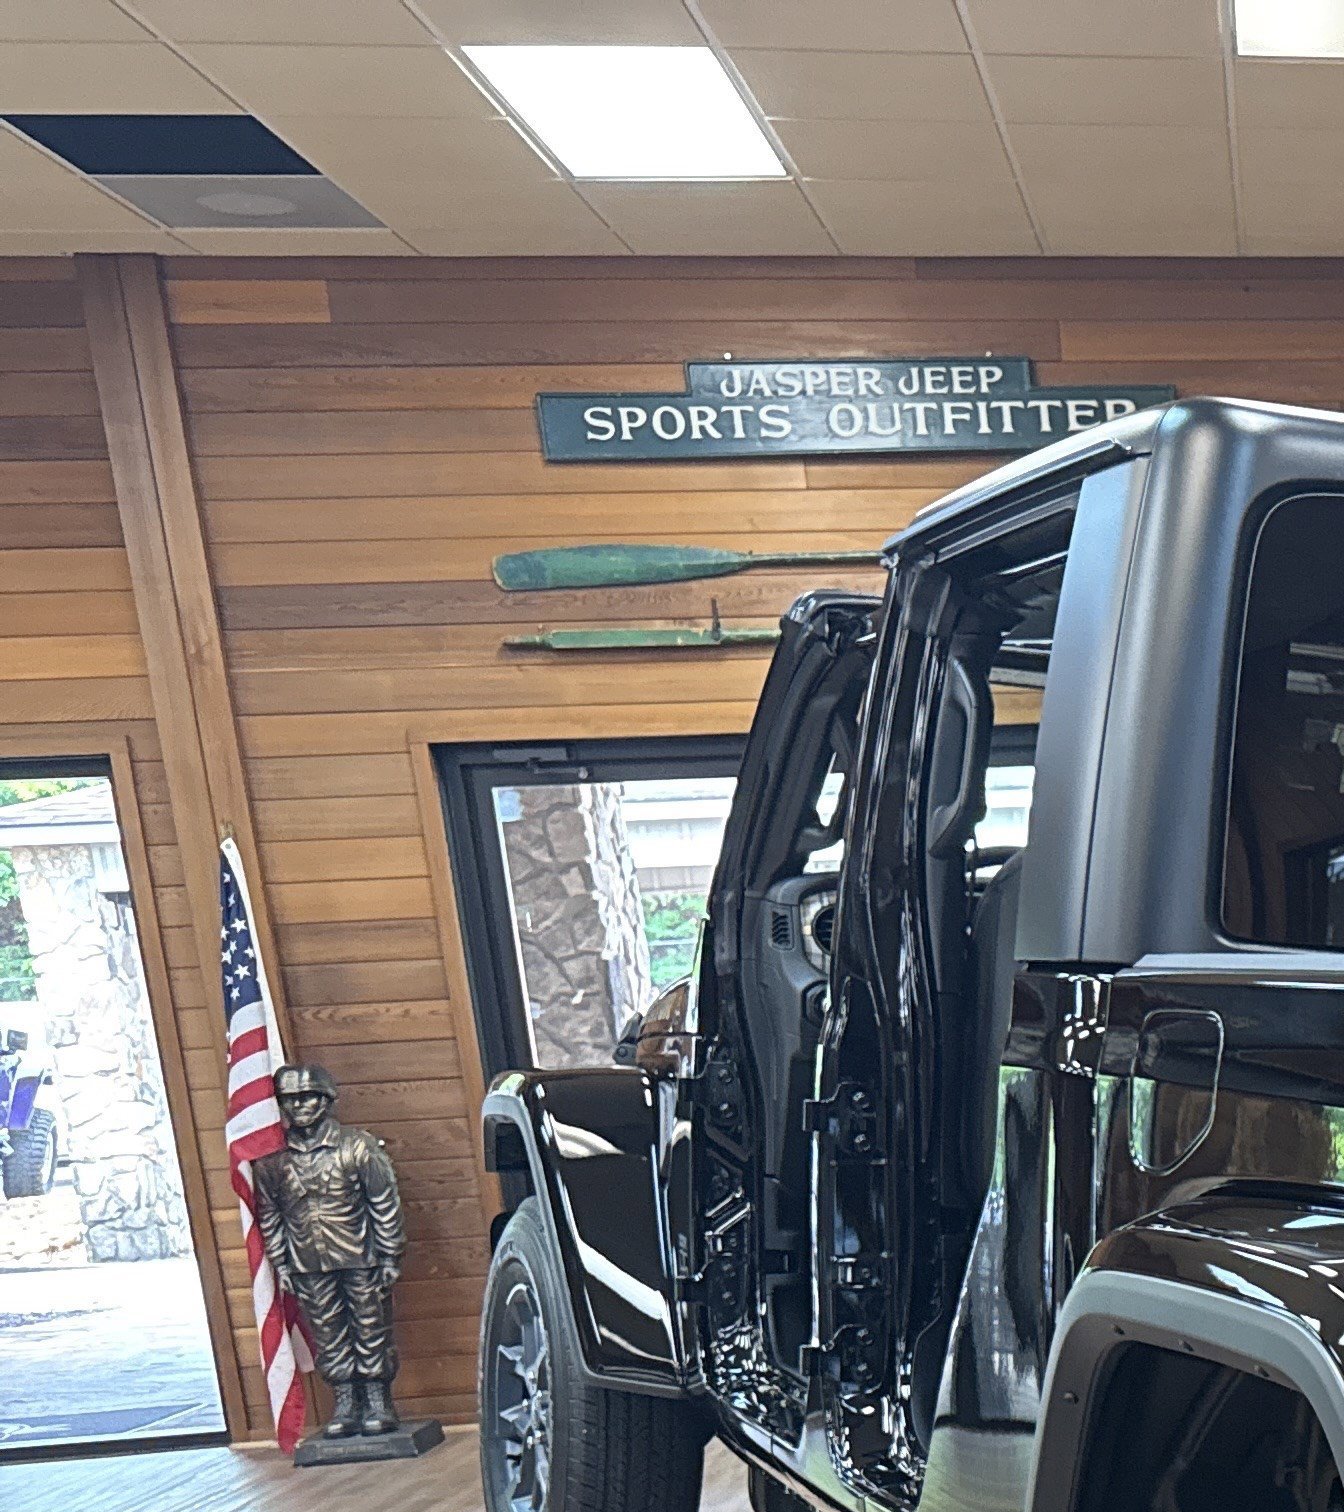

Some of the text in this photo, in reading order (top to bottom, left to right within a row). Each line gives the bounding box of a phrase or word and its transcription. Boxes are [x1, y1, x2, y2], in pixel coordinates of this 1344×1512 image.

[719, 365, 1004, 398] JASPER JEEP
[582, 402, 794, 441] SPORTS
